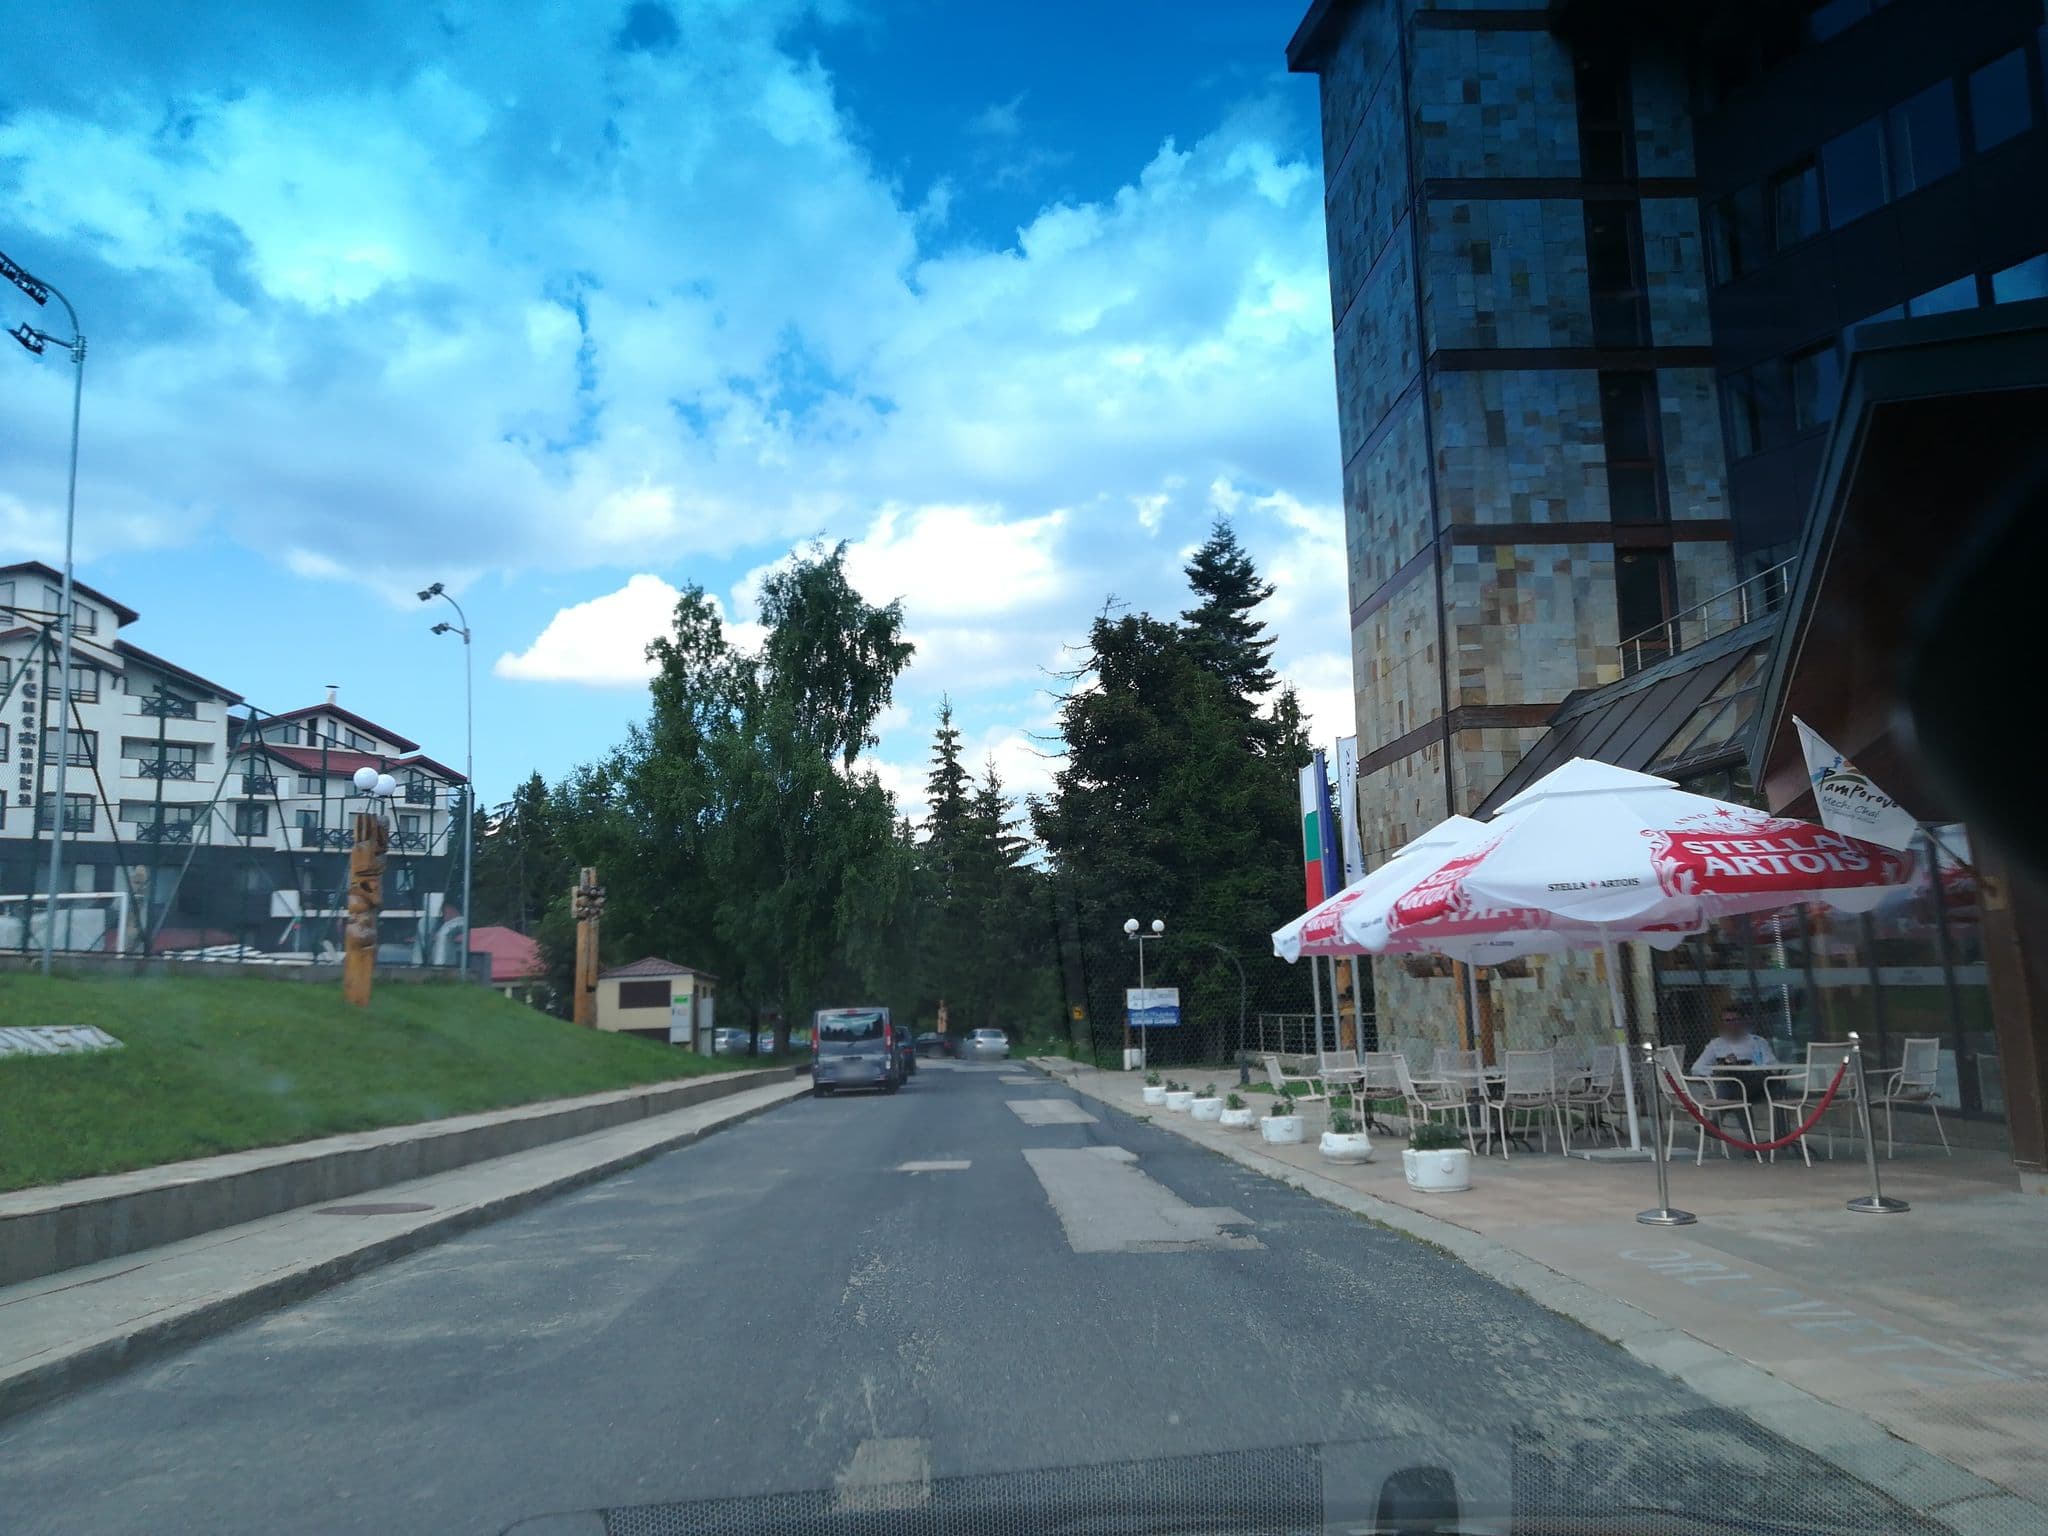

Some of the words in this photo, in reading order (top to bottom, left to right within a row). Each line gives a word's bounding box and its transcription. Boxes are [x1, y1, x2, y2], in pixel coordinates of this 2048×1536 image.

[1682, 834, 1848, 856] STELLA
[1703, 850, 1871, 877] ARTOIS
[1547, 882, 1588, 892] STELLA
[1599, 877, 1640, 888] ARTOIS
